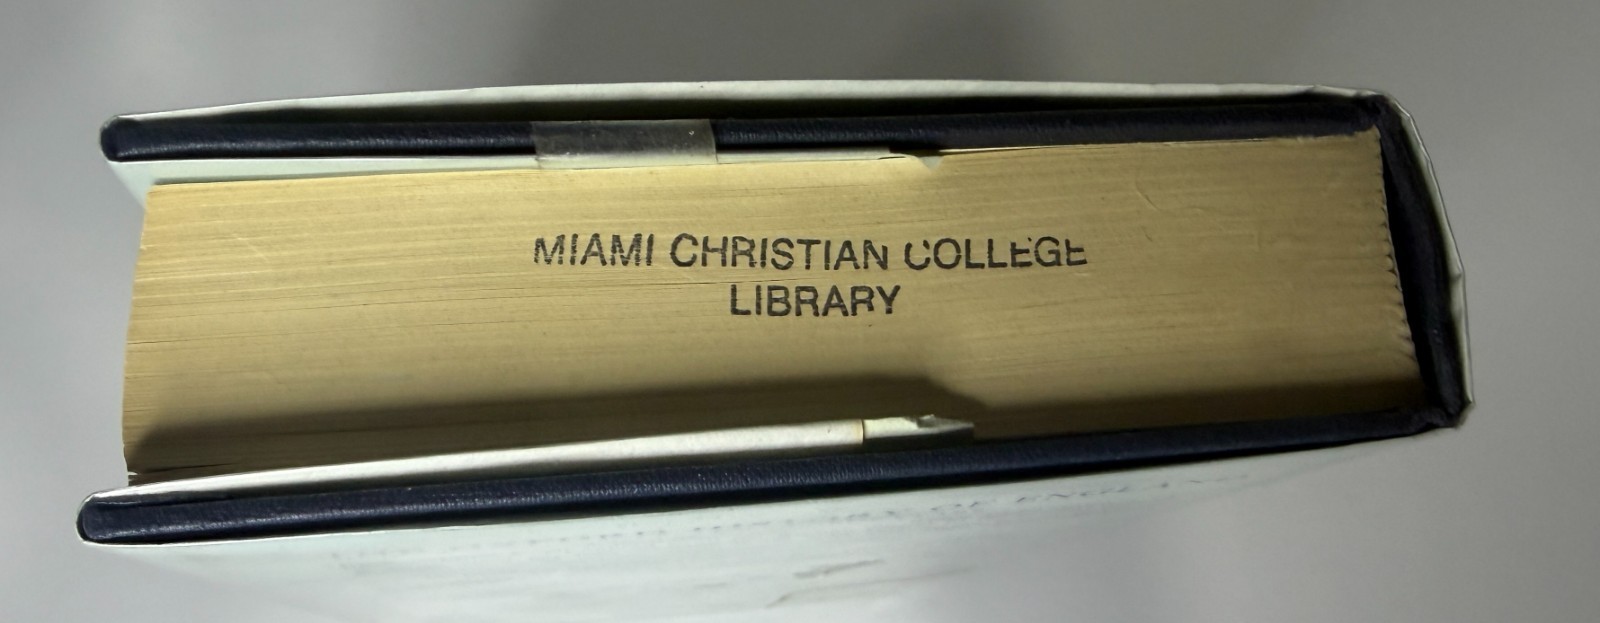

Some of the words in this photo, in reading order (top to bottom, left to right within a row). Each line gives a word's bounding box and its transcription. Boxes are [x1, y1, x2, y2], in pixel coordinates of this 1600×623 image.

[533, 232, 655, 267] MIAMI
[669, 232, 889, 271] CHRISTIAN
[904, 236, 1088, 271] COLLEGE
[729, 283, 901, 317] LIBRARY
